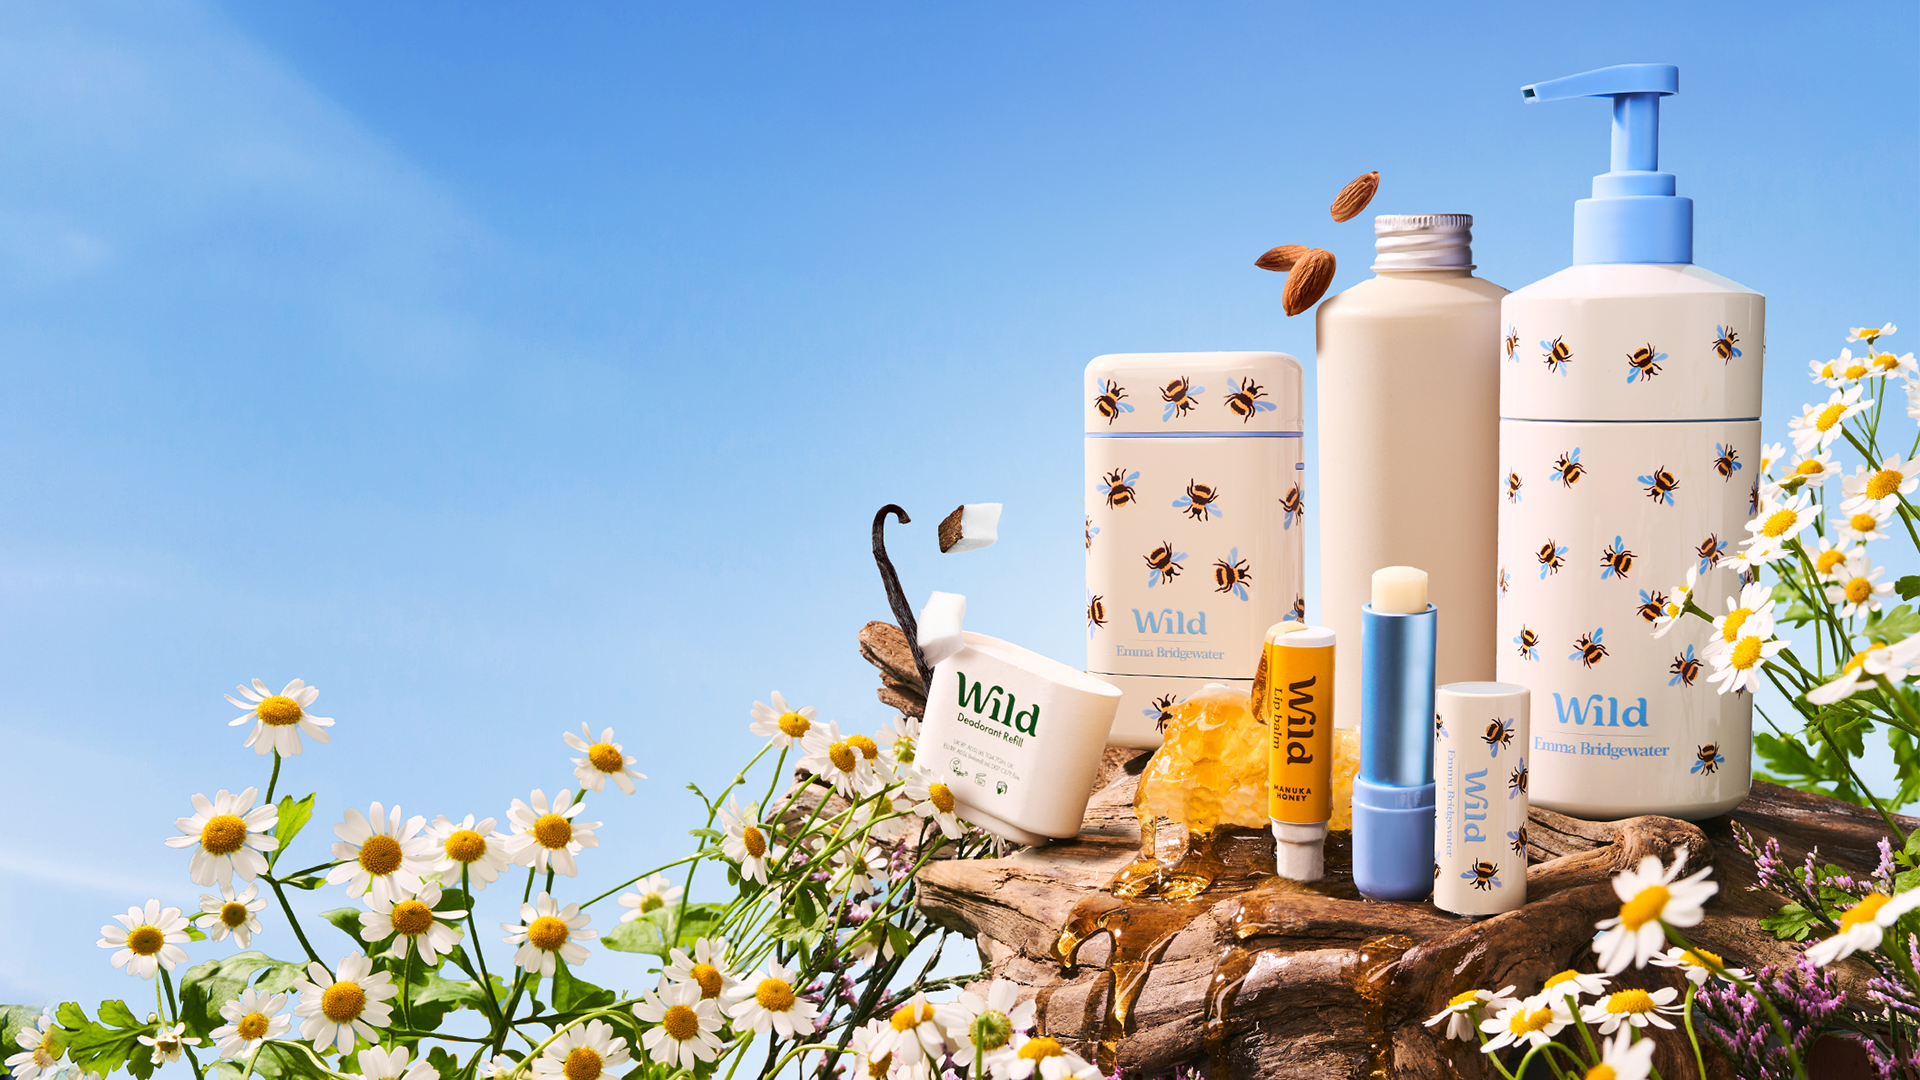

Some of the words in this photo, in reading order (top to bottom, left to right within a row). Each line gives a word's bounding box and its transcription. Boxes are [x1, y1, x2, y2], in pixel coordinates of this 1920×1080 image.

[1131, 608, 1208, 635] Wild
[1116, 645, 1154, 657] Emma
[1156, 646, 1225, 661] Bridgewater
[956, 671, 1040, 737] Wild
[1273, 687, 1283, 710] Lip
[1552, 692, 1649, 727] Wild
[957, 712, 1002, 738] Deodorant
[1003, 731, 1024, 748] Refill
[1273, 714, 1283, 750] balm
[1287, 675, 1316, 765] Wild
[1534, 736, 1576, 755] Emma
[1580, 741, 1670, 760] Bridgewater
[1446, 749, 1456, 787] Emma
[1273, 784, 1312, 795] MANUKA
[1276, 792, 1307, 802] HONEY
[1463, 767, 1489, 843] Wild
[1445, 790, 1455, 858] Bridgewater
